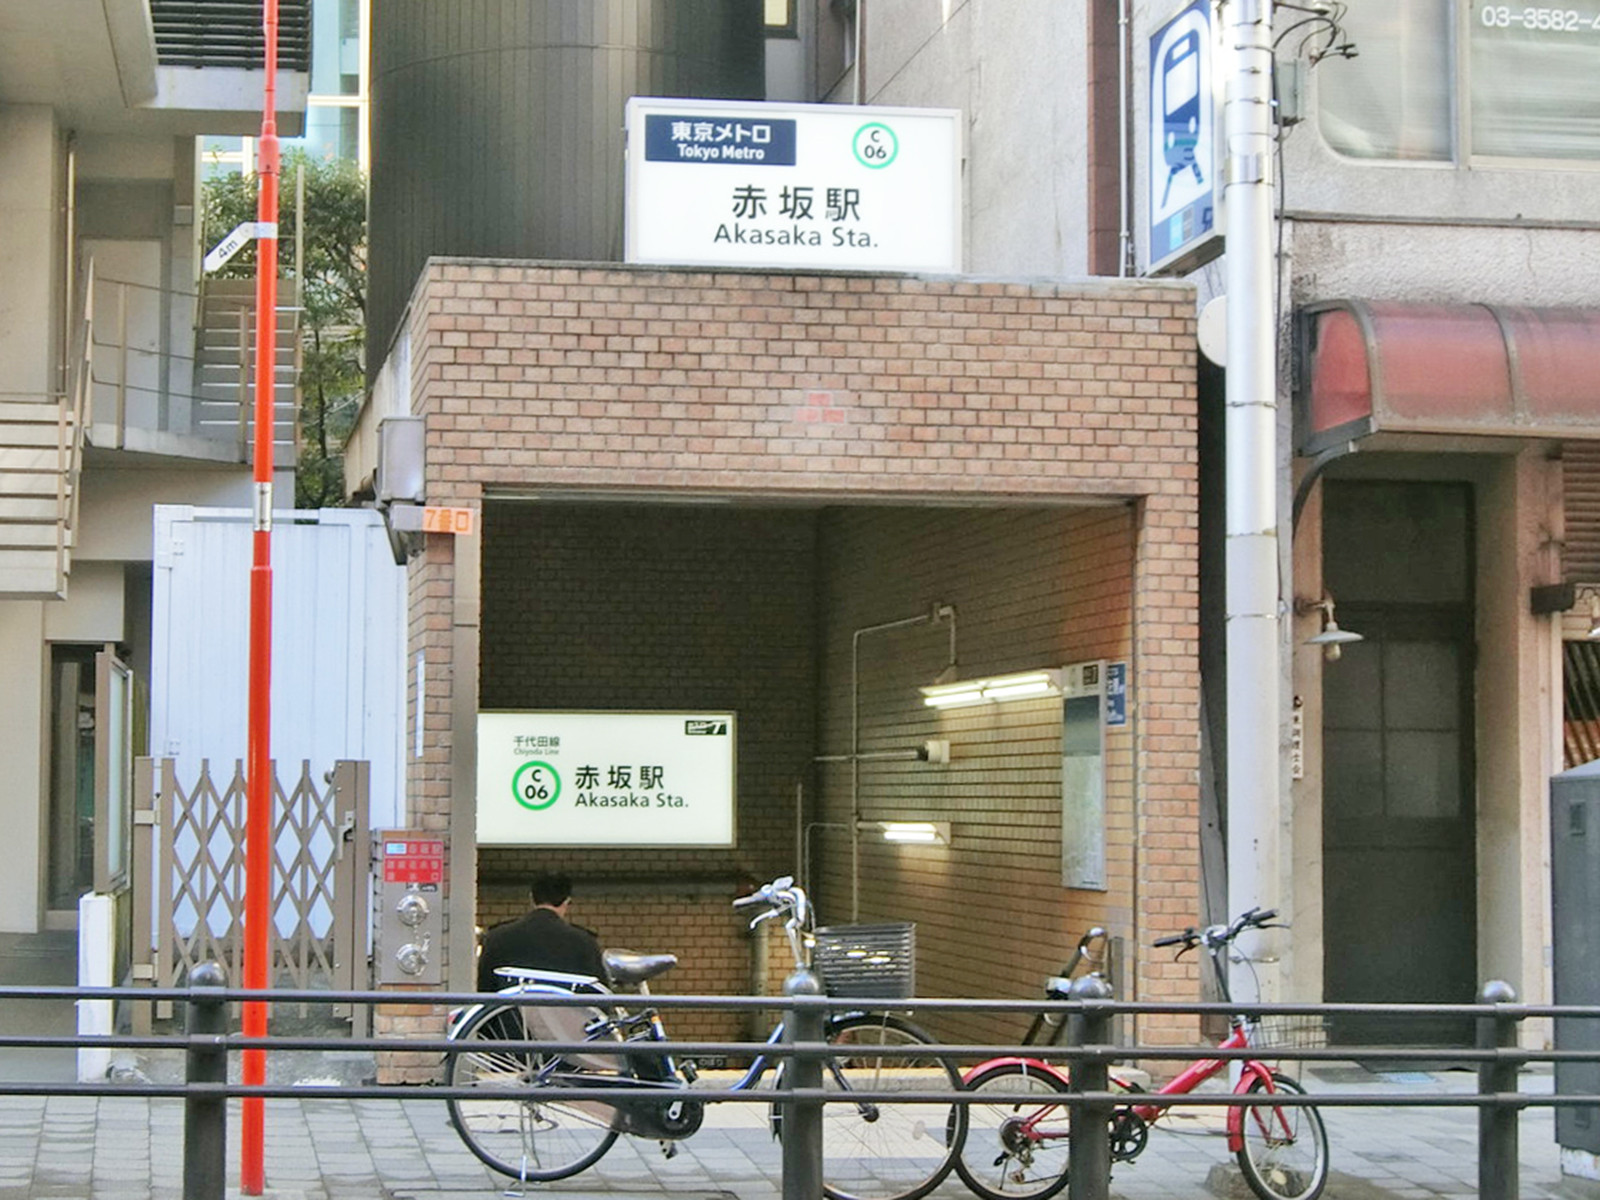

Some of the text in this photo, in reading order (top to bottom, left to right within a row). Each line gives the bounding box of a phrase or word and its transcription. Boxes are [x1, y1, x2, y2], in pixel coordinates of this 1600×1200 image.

[671, 120, 771, 143] 東京メトロ
[870, 130, 880, 143] C
[677, 143, 765, 160] Tokyo Metro
[864, 145, 886, 159] 06
[732, 185, 860, 221] 赤坂駅
[714, 223, 878, 248] Akasaka Sta.
[219, 240, 238, 258] 4m
[513, 736, 560, 747] 千代田線
[532, 769, 542, 782] C
[575, 765, 663, 790] 赤坂駅
[525, 785, 548, 799] 06
[575, 792, 688, 808] Akasaka Sta.
